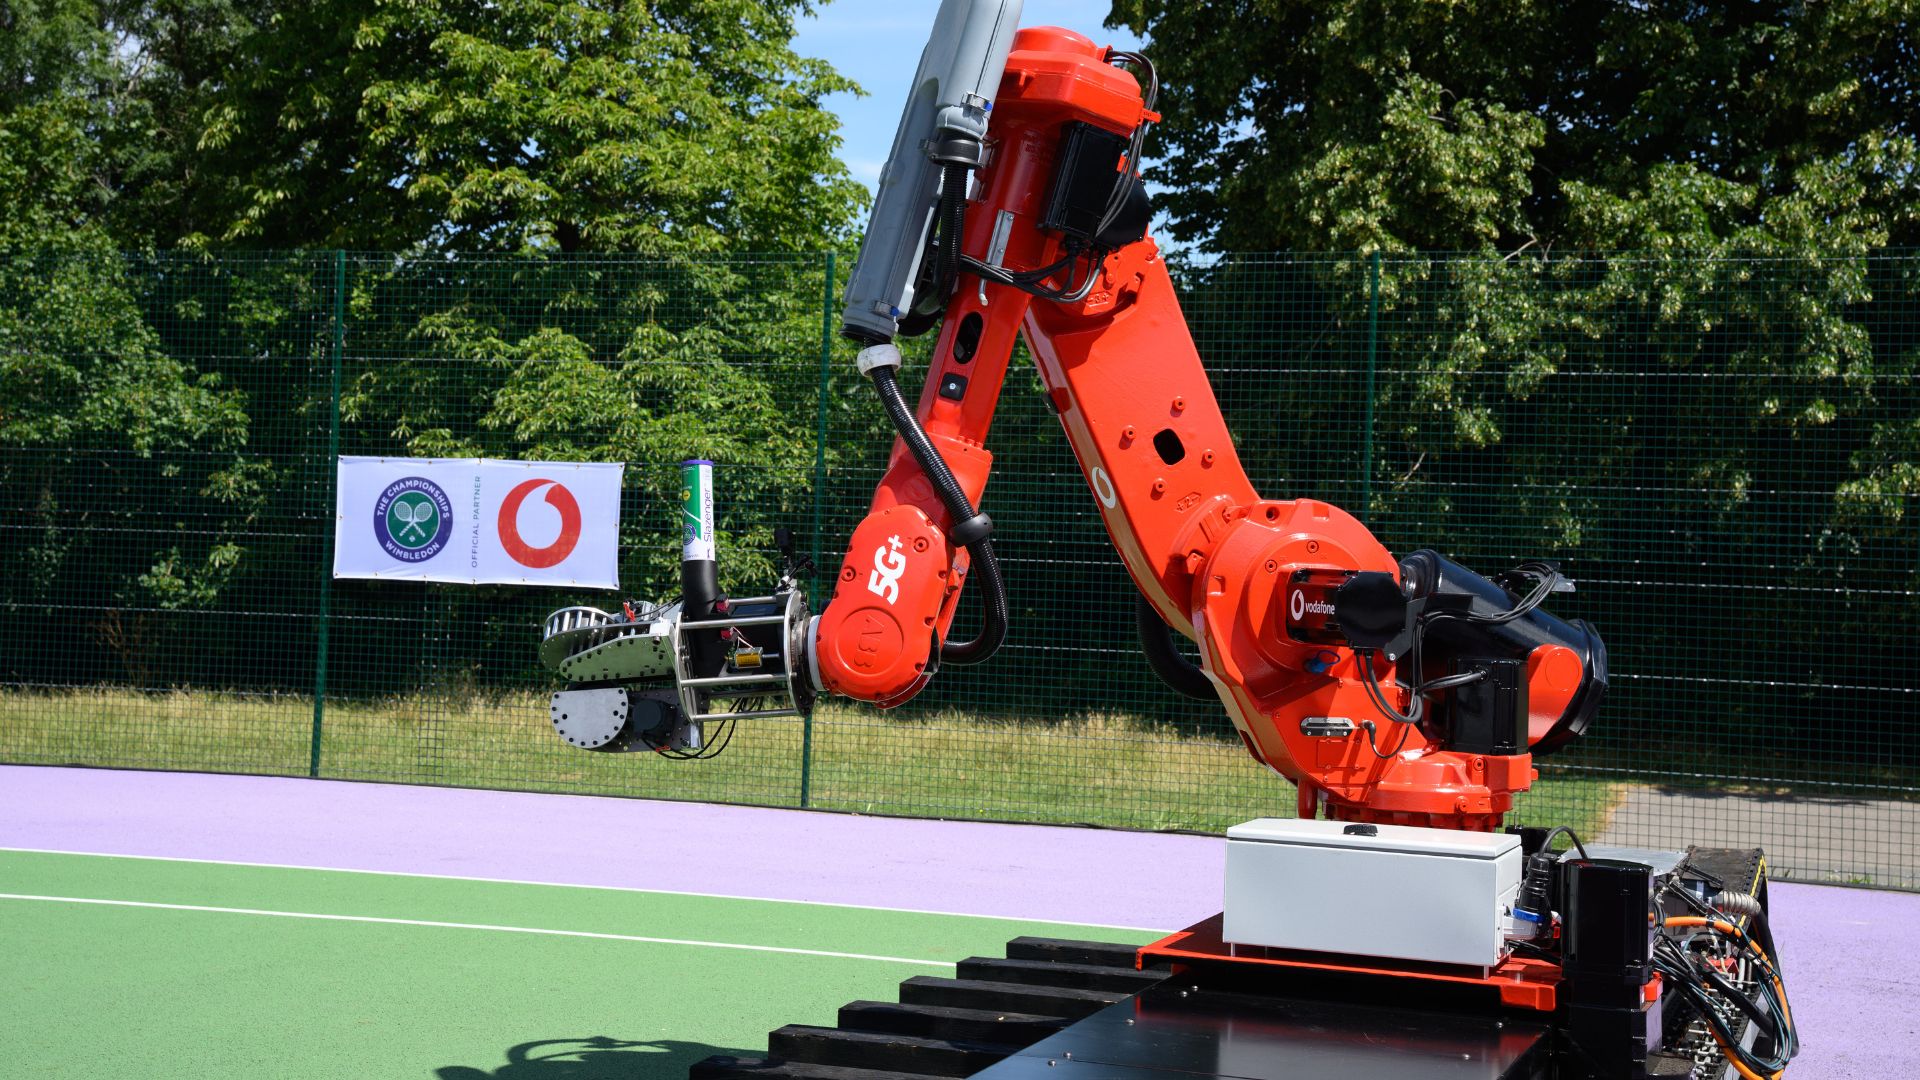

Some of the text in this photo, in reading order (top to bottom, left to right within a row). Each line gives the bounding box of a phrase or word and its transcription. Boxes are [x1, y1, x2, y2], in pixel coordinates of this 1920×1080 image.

[377, 480, 450, 519] THE CHAMPIONSHIPS
[471, 475, 481, 568] OFFICIAL PARTNER
[704, 489, 712, 543] Slazenger
[385, 540, 441, 560] WIMBLEDON
[867, 534, 907, 606] 5G+
[1305, 599, 1335, 615] vodafone
